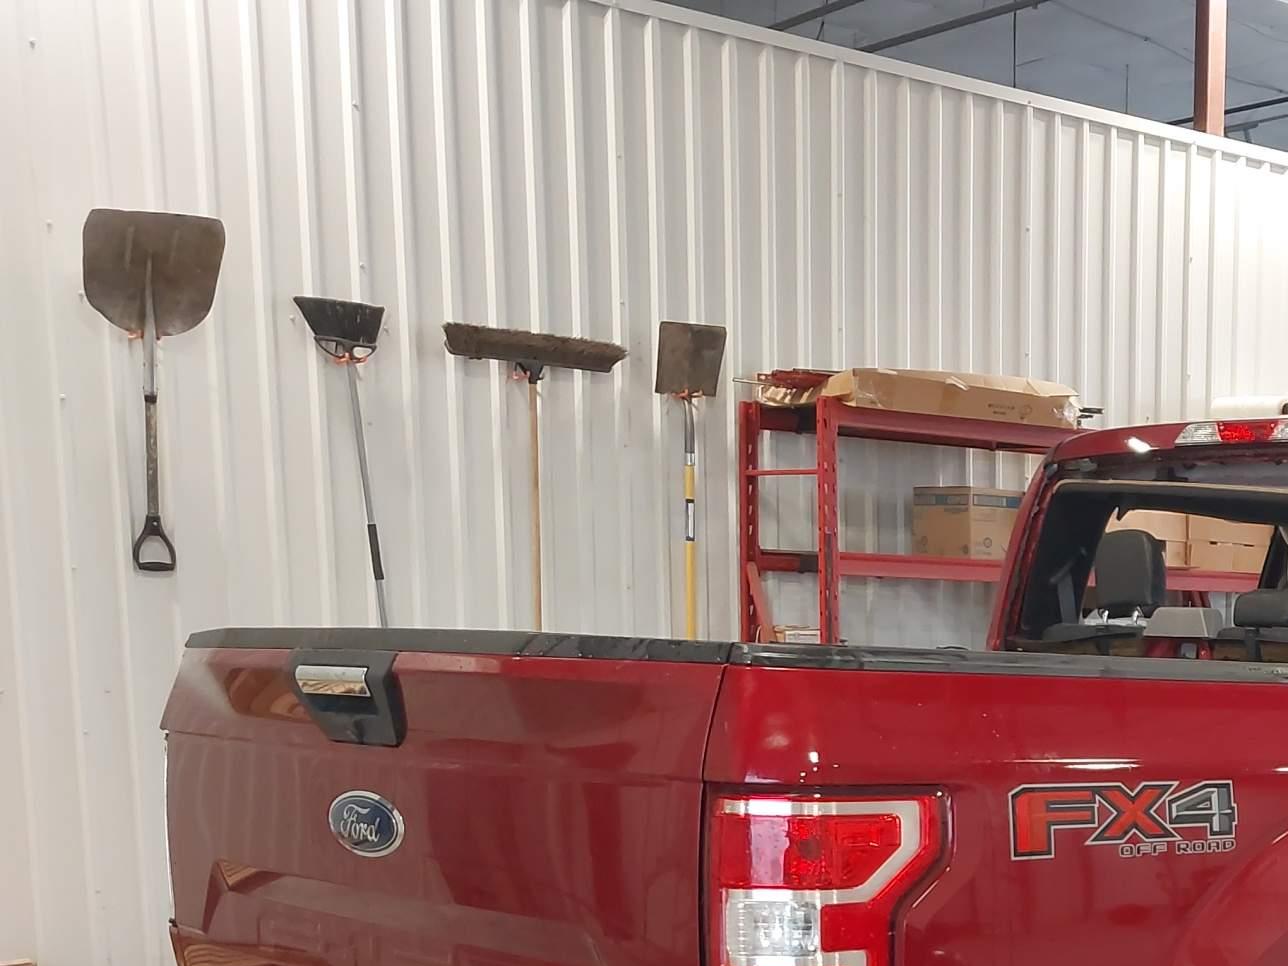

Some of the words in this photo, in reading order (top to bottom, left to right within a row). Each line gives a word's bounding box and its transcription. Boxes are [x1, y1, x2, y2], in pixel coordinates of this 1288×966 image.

[340, 804, 381, 842] Ford
[1008, 780, 1237, 860] FX4
[1119, 843, 1167, 858] OFF
[1176, 838, 1236, 855] ROAD
